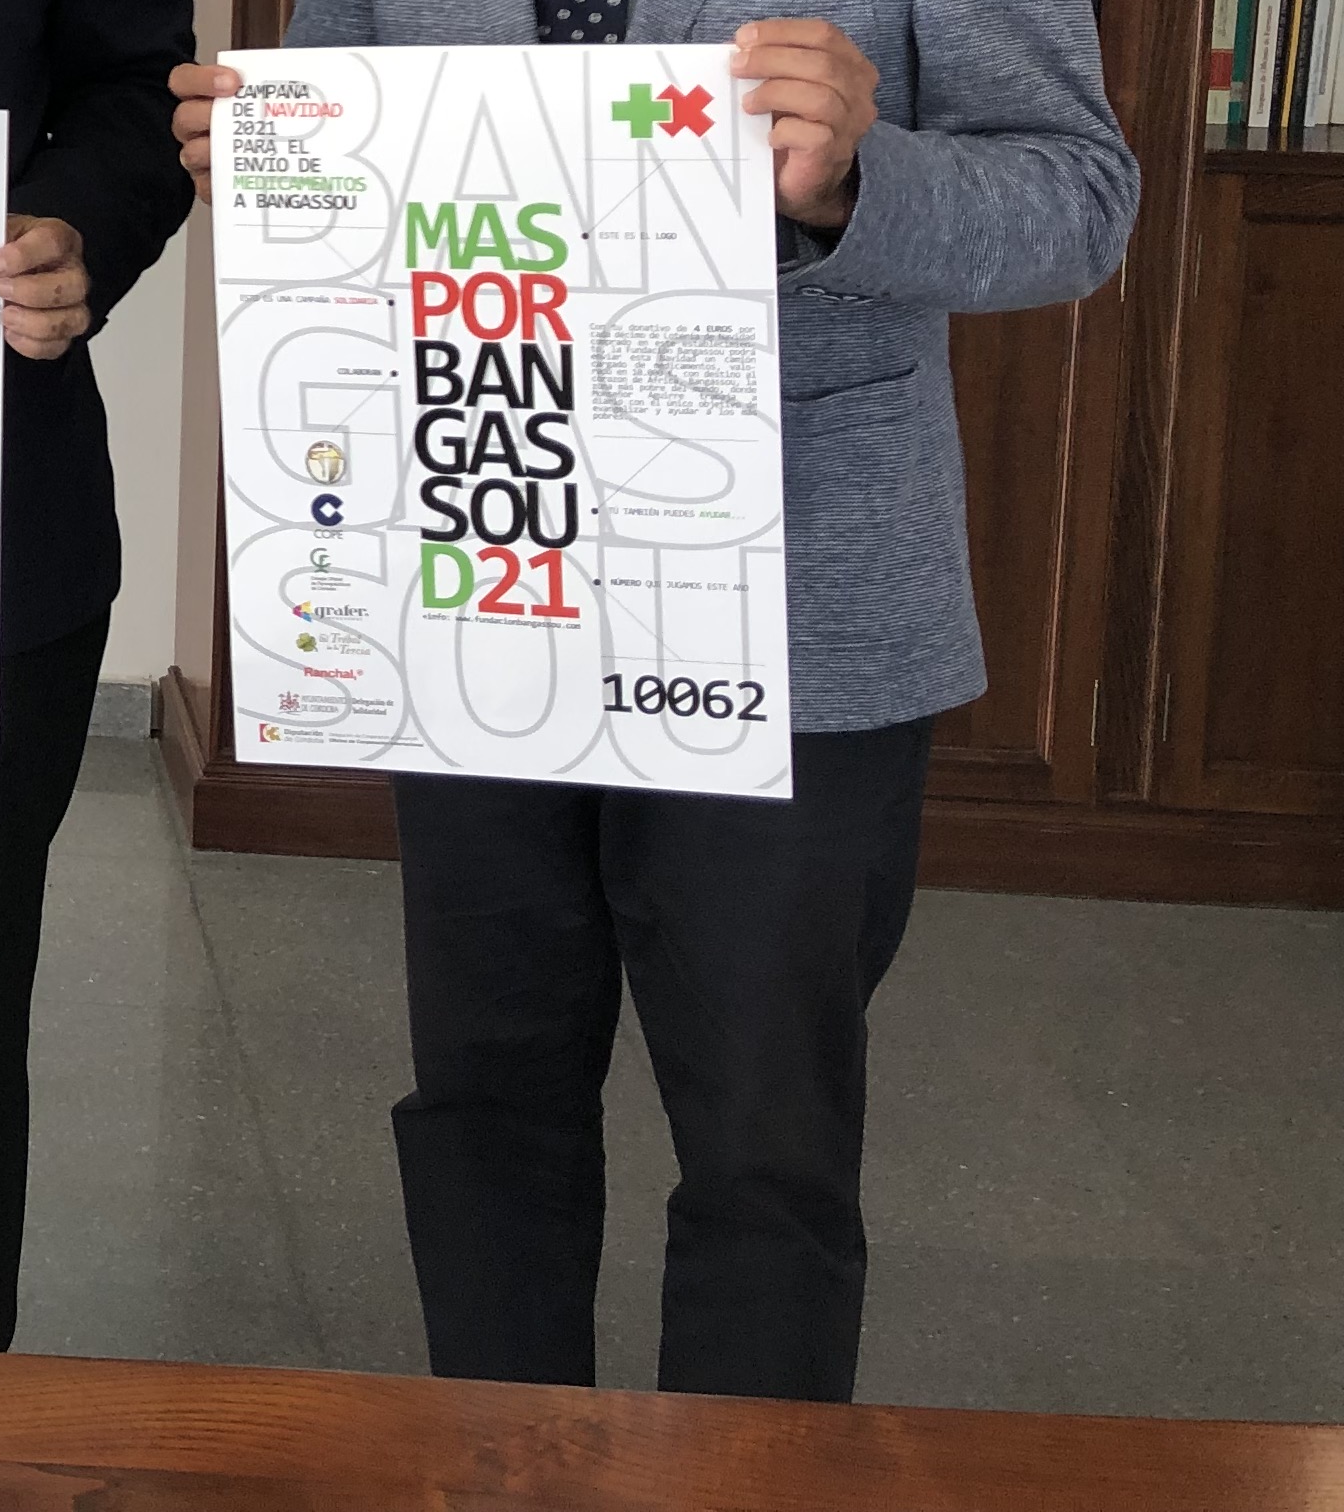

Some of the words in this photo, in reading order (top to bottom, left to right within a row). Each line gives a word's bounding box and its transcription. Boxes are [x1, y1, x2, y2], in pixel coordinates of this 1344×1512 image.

[233, 102, 254, 116] DE
[265, 102, 343, 117] NAVIDAD
[233, 120, 277, 135] 2021
[233, 139, 277, 153] PARA
[288, 139, 309, 154] EL
[233, 153, 289, 172] ENVÍO
[299, 157, 321, 172] DE
[233, 175, 367, 191] MEDICAMENTOS
[233, 194, 245, 208] A
[256, 194, 356, 209] BANGASSOU
[403, 200, 568, 272] MAS
[410, 269, 574, 342] POR
[414, 339, 575, 411] BAN
[412, 406, 577, 481] GAS
[418, 474, 580, 549] SOU
[314, 529, 343, 539] COPE
[419, 543, 580, 618] D21
[602, 672, 768, 721] 10062
